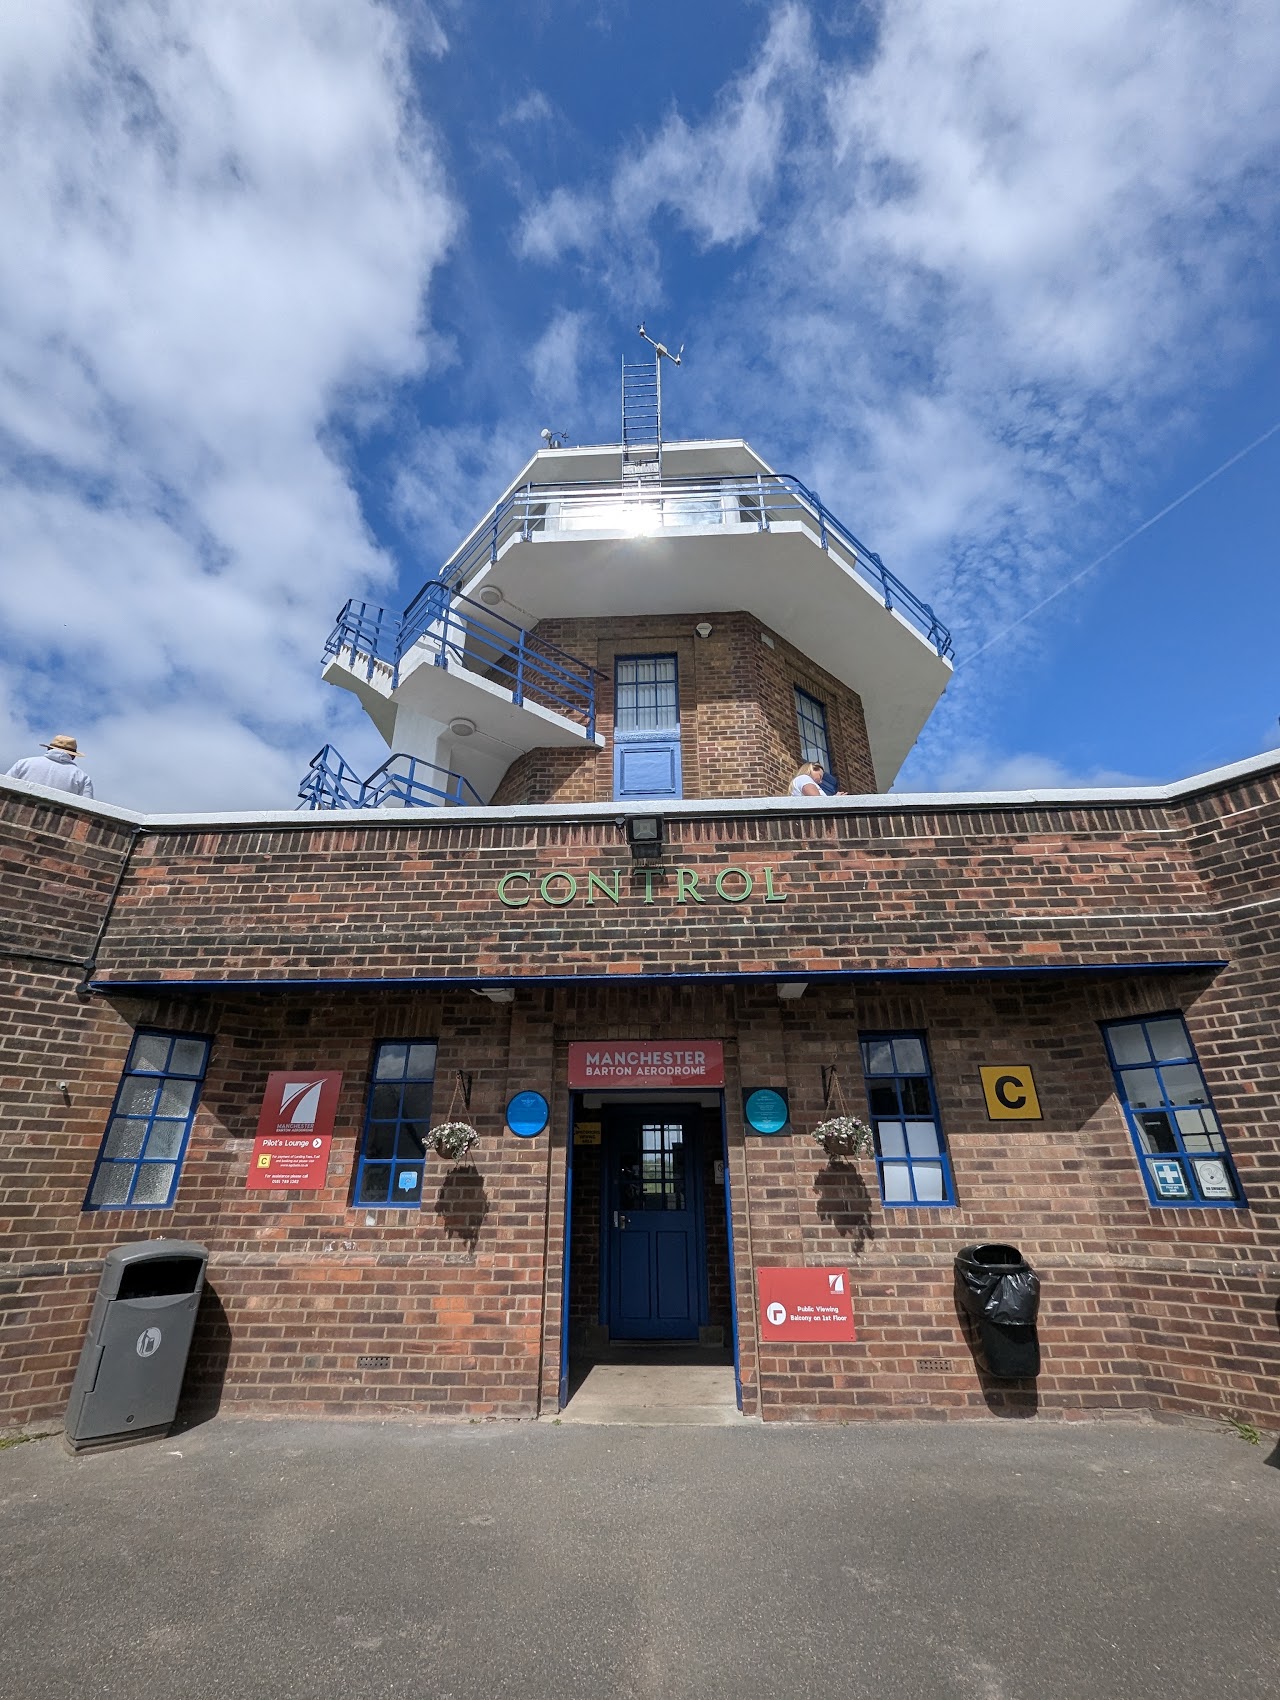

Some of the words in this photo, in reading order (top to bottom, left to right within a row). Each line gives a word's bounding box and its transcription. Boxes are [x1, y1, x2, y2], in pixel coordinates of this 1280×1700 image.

[497, 866, 788, 907] CONTROL
[586, 1051, 705, 1066] MANCHESTER
[586, 1066, 632, 1076] BARTON
[636, 1066, 706, 1075] AERODROME
[994, 1075, 1027, 1109] C
[262, 1139, 283, 1147] Pilot's
[284, 1139, 310, 1148] Lounge
[261, 1157, 268, 1165] C
